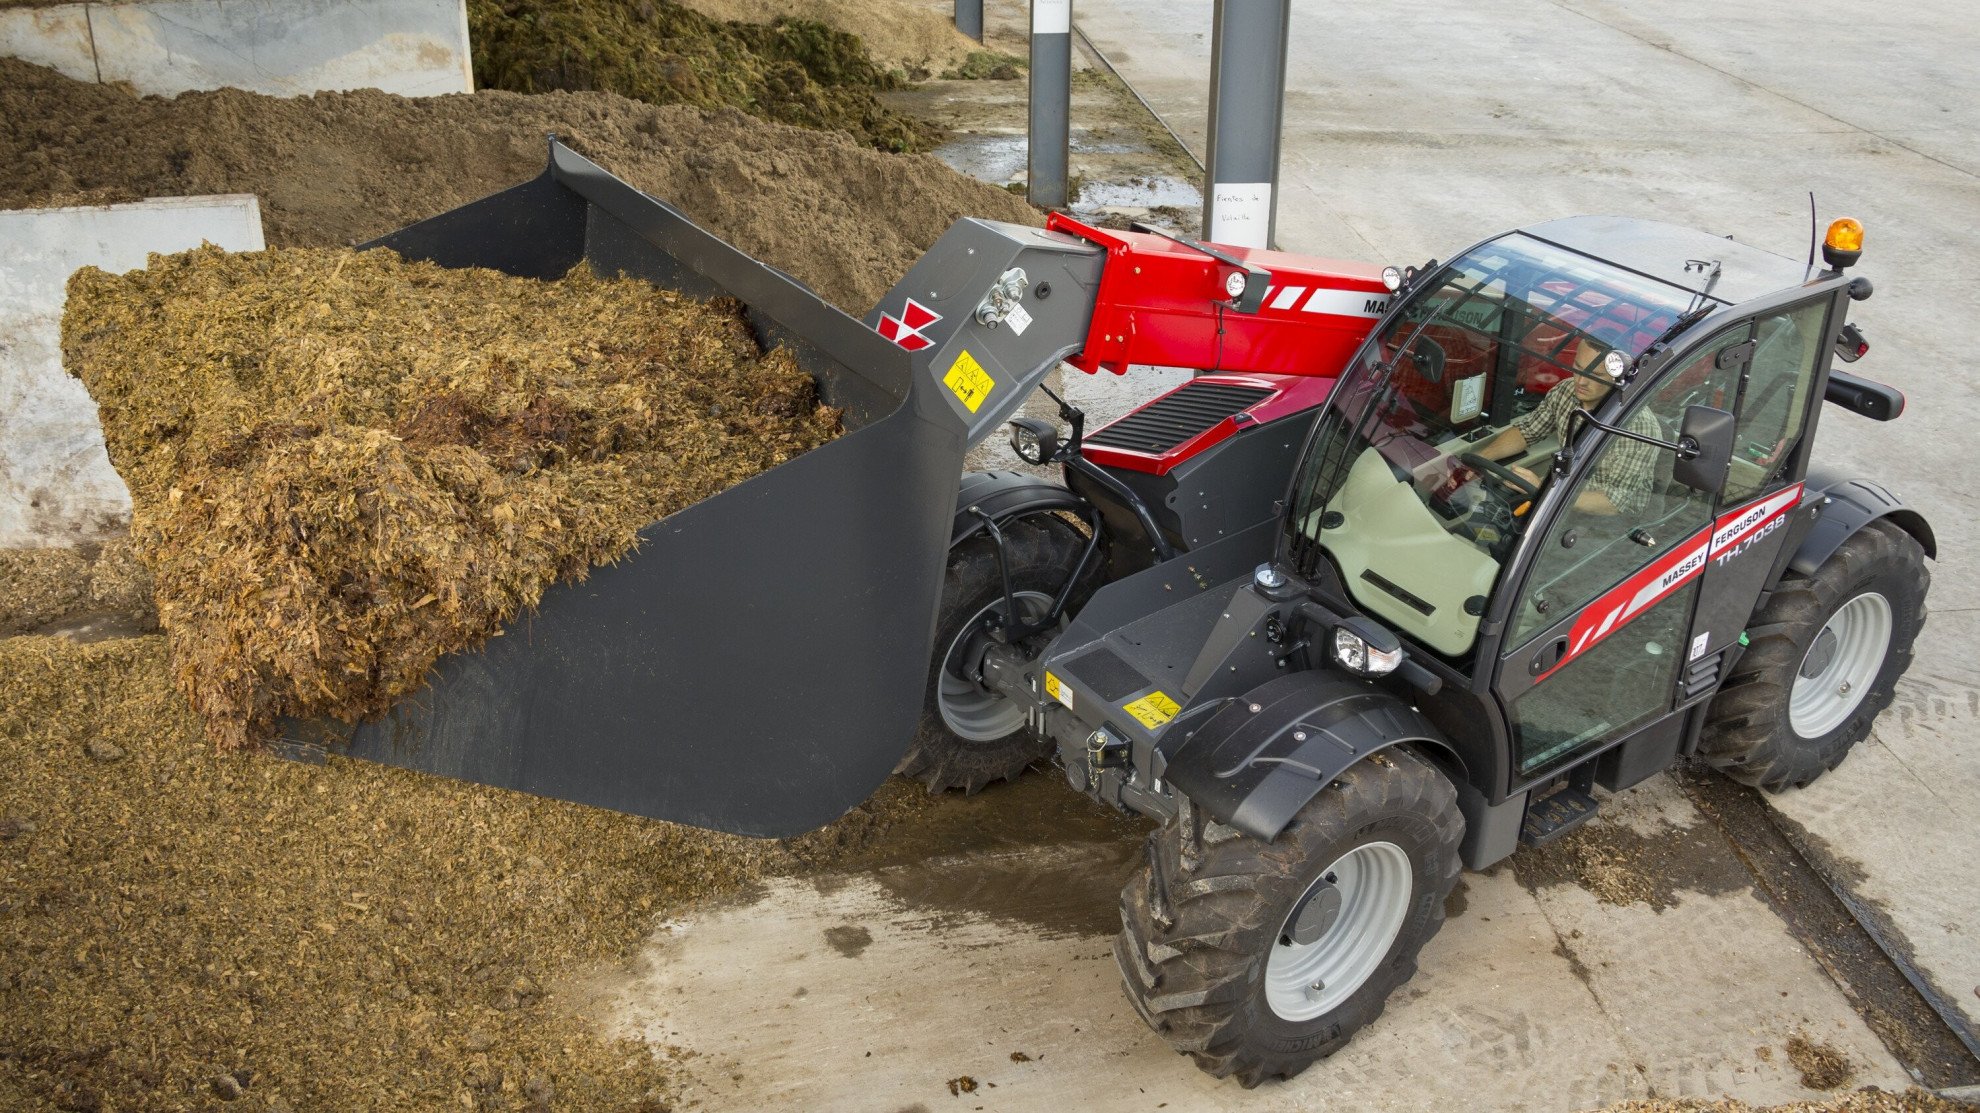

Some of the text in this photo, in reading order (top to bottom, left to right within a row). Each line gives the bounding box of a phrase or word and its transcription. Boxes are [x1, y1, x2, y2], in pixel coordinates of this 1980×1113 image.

[1662, 506, 1767, 588] MASSEY FERGUSON
[1716, 513, 1786, 567] TH.7038
